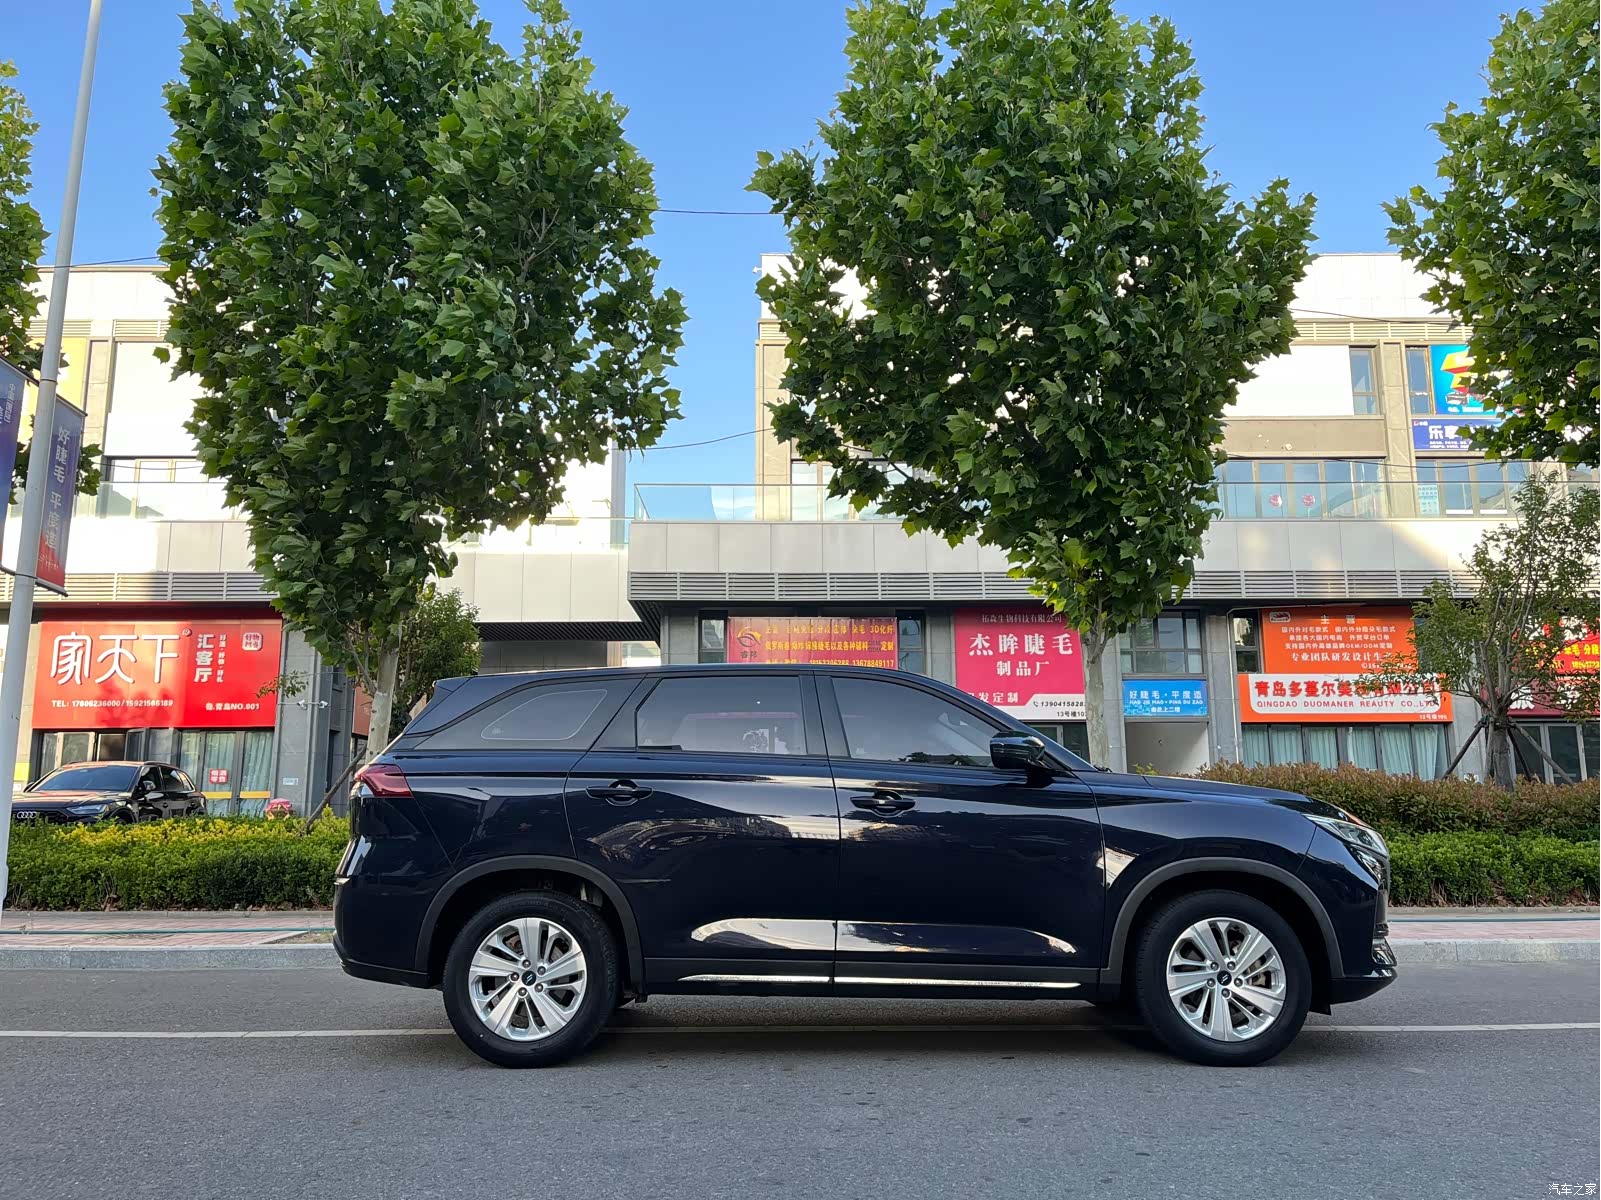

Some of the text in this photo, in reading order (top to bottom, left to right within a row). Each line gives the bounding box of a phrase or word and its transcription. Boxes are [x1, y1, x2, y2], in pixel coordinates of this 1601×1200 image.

[969, 633, 1073, 656] 杰眸睫毛
[50, 632, 180, 685] 家天下
[194, 634, 215, 683] 汇客厅
[996, 661, 1050, 676] 制品厂
[967, 692, 1019, 704] 发定制
